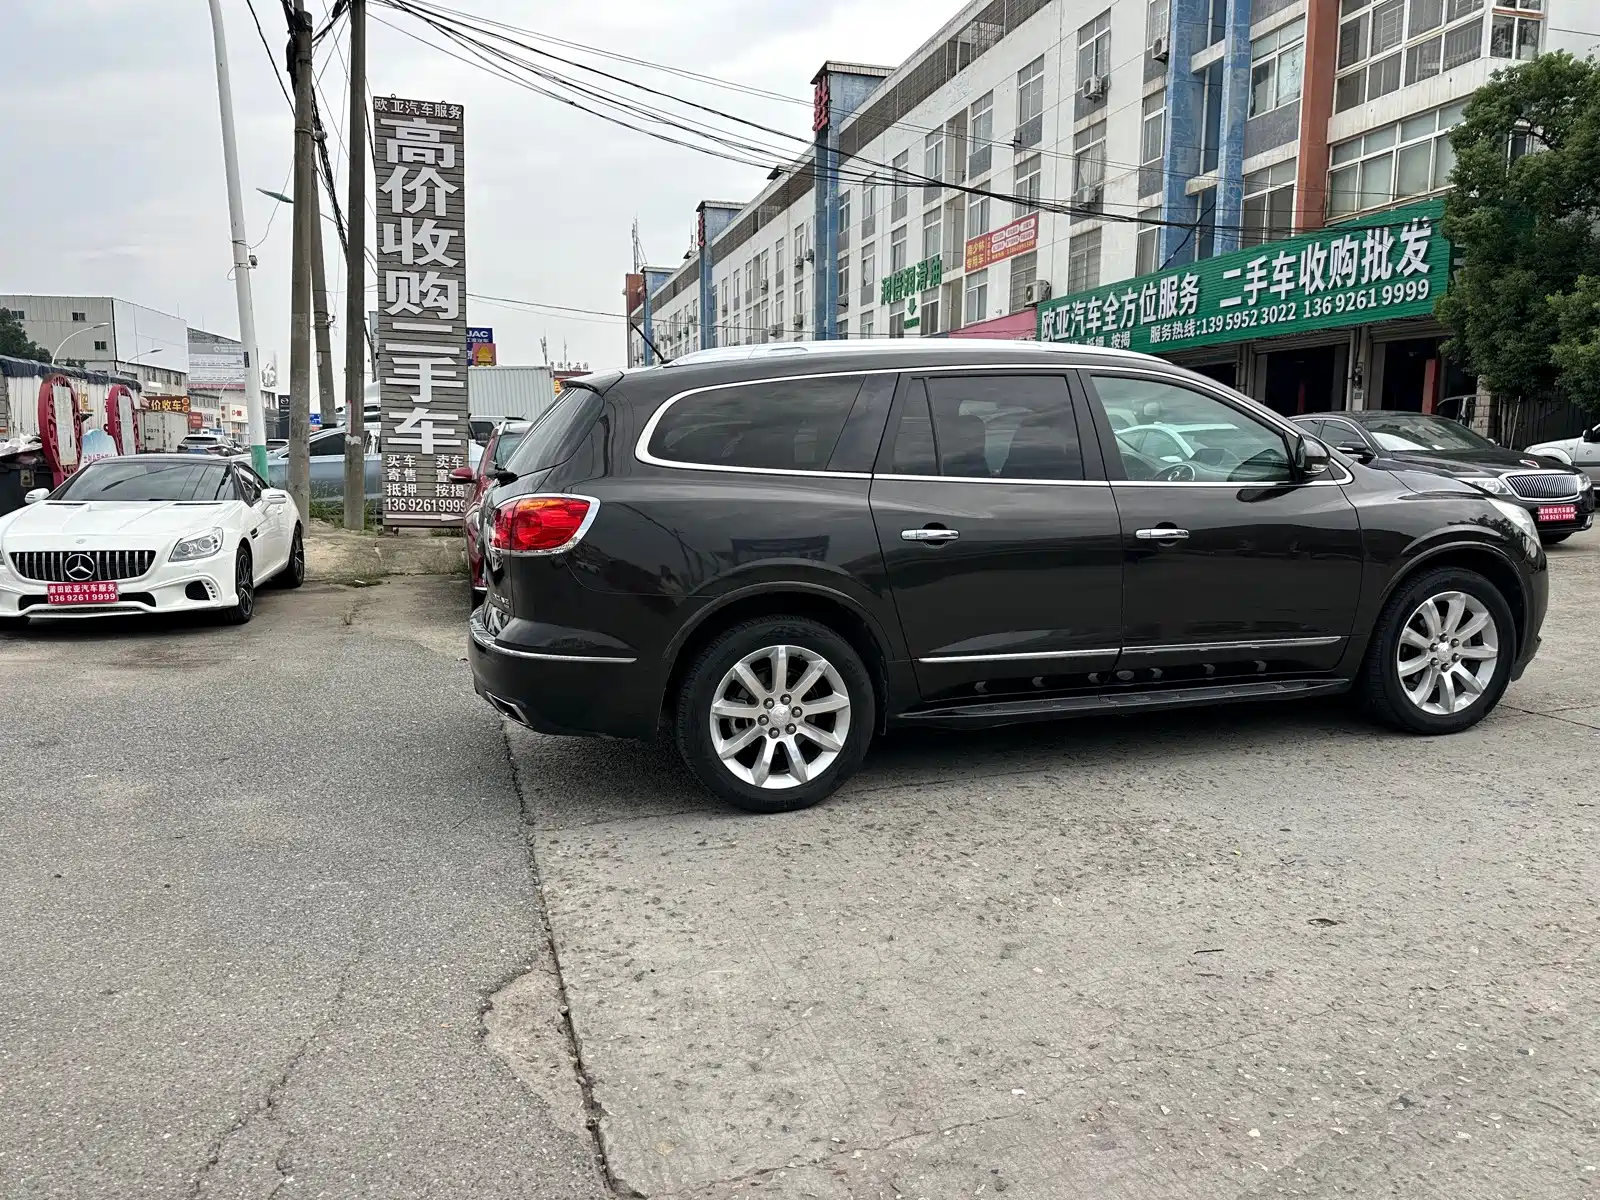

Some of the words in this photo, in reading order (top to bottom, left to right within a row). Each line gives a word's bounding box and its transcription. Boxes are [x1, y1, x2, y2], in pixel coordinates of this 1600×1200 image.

[375, 98, 462, 119] 欧亚汽车服务
[1219, 215, 1432, 308] 二手车收购批发
[379, 118, 464, 454] 高价收购二手车
[1041, 272, 1200, 342] 欧亚汽车全方位服务
[1225, 309, 1258, 330] 5952
[1260, 302, 1297, 325] 3022
[1303, 295, 1332, 318] 136
[1335, 287, 1376, 313] 9261
[1381, 278, 1430, 306] 9999
[1111, 332, 1130, 348] 按揭
[150, 400, 181, 411] 价收车
[387, 454, 416, 467] 买车
[436, 455, 464, 468] 卖车
[387, 468, 416, 482] 寄售
[386, 483, 417, 497] 抵押
[435, 484, 465, 497] 按揭
[386, 498, 407, 511] 136
[408, 499, 436, 511] 9261
[438, 500, 467, 512] 9999
[49, 584, 116, 593] 莆田欧亚汽车服务
